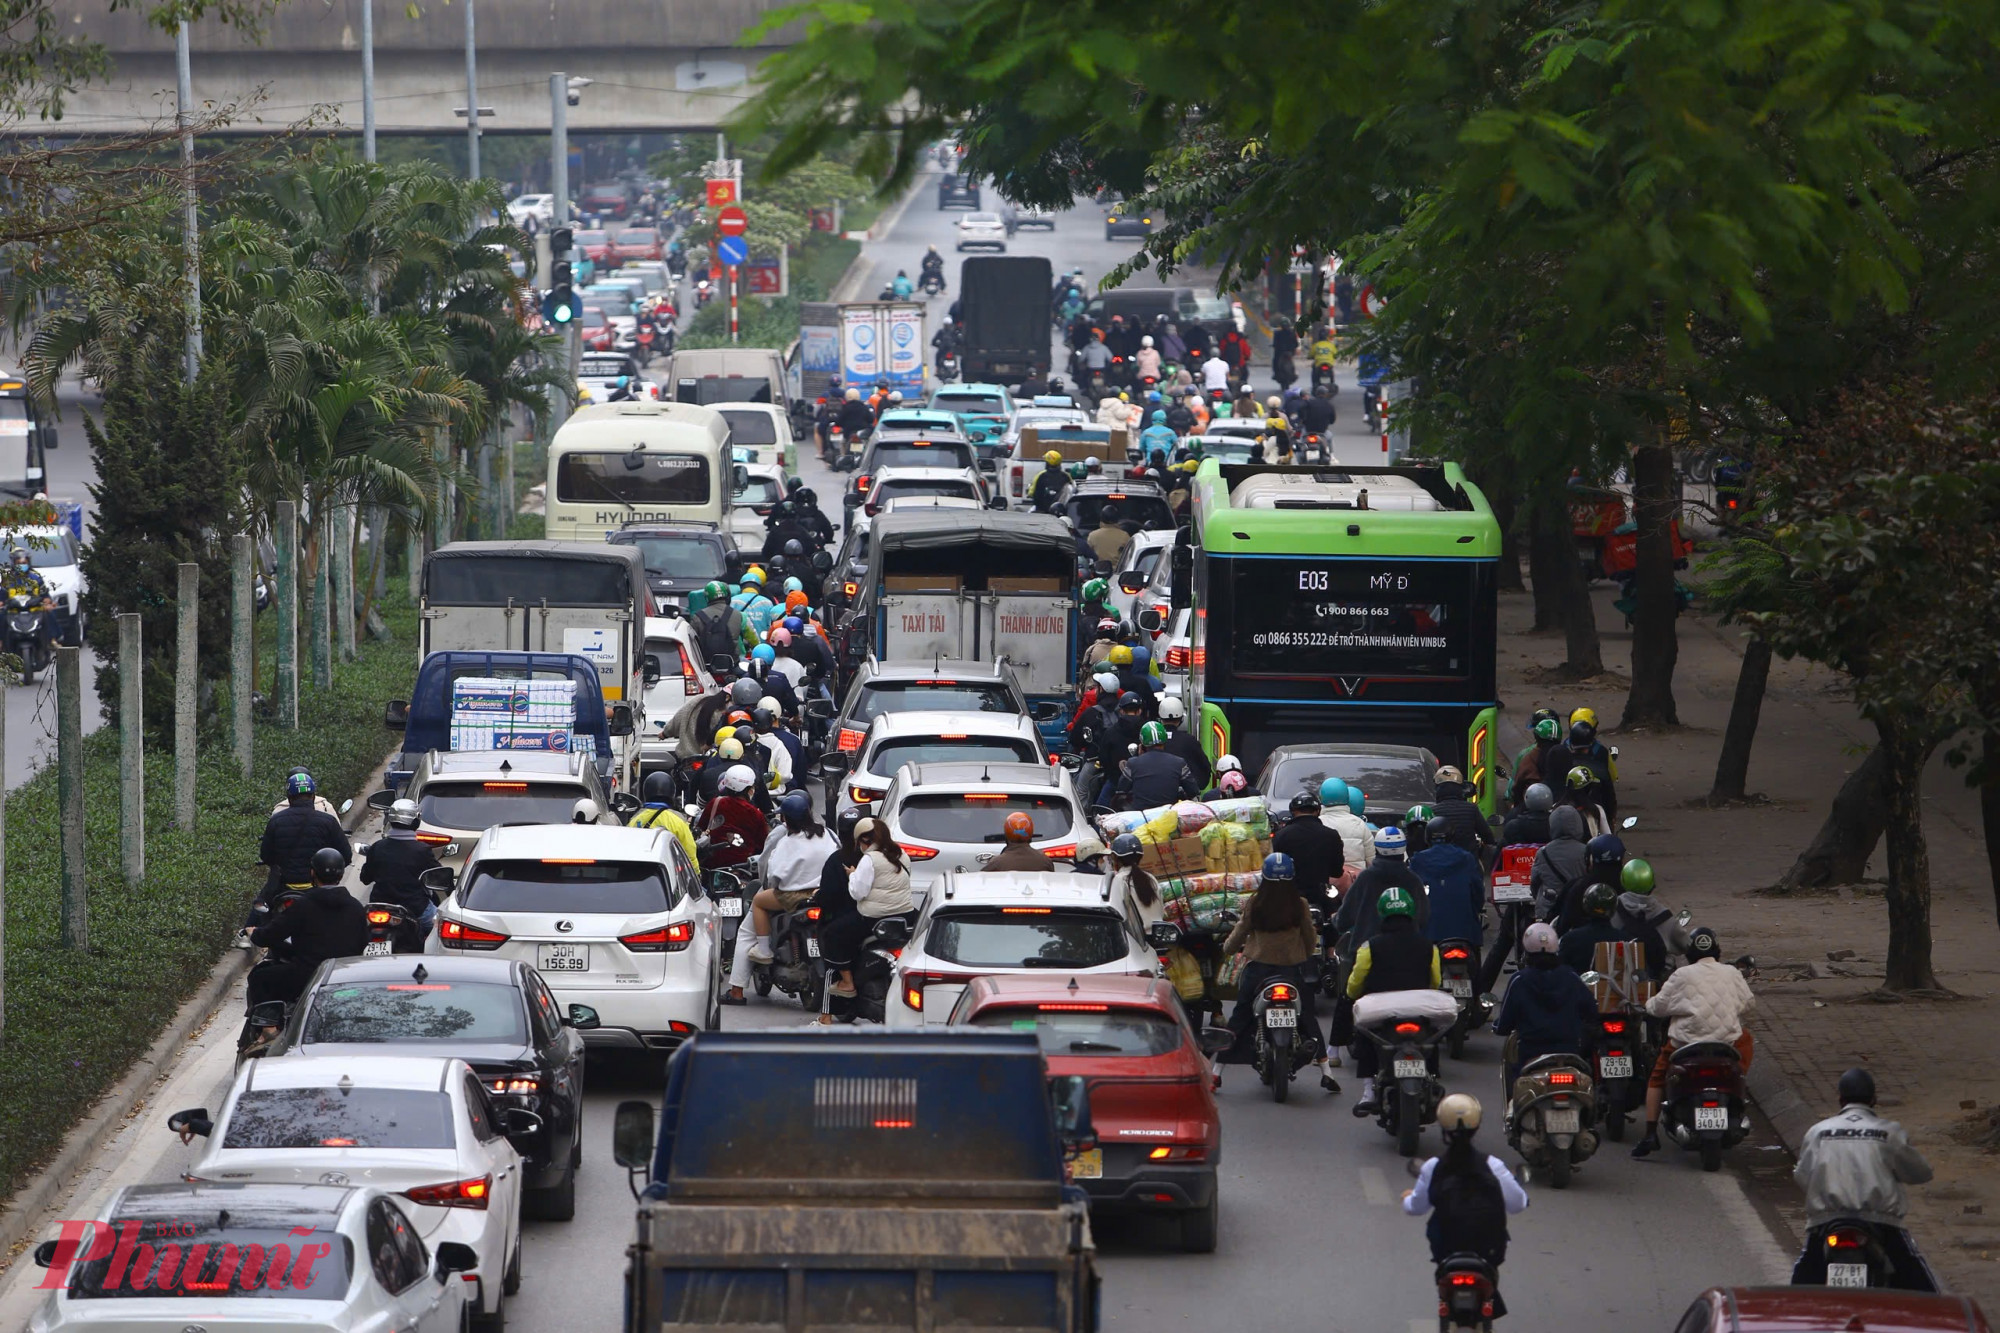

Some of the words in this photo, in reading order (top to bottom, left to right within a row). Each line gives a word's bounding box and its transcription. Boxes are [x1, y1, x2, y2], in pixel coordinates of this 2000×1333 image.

[596, 512, 671, 524] HYUNDAI
[1299, 570, 1328, 590] E03
[1370, 572, 1392, 589] MỸ
[1323, 607, 1347, 615] 1900
[1349, 607, 1368, 615] 866
[1371, 607, 1389, 615] 663
[1035, 616, 1063, 634] HƯNG
[1253, 633, 1266, 647] GỌI
[1268, 631, 1290, 645] 0866
[1292, 632, 1309, 645] 355
[1310, 633, 1327, 646] 222
[1339, 632, 1354, 646] TRỞ
[1355, 633, 1380, 647] THÀNH
[1381, 634, 1402, 647] NHÂN
[1402, 634, 1419, 647] VIÊN
[1420, 637, 1446, 648] VINBUS
[553, 946, 575, 957] 30H
